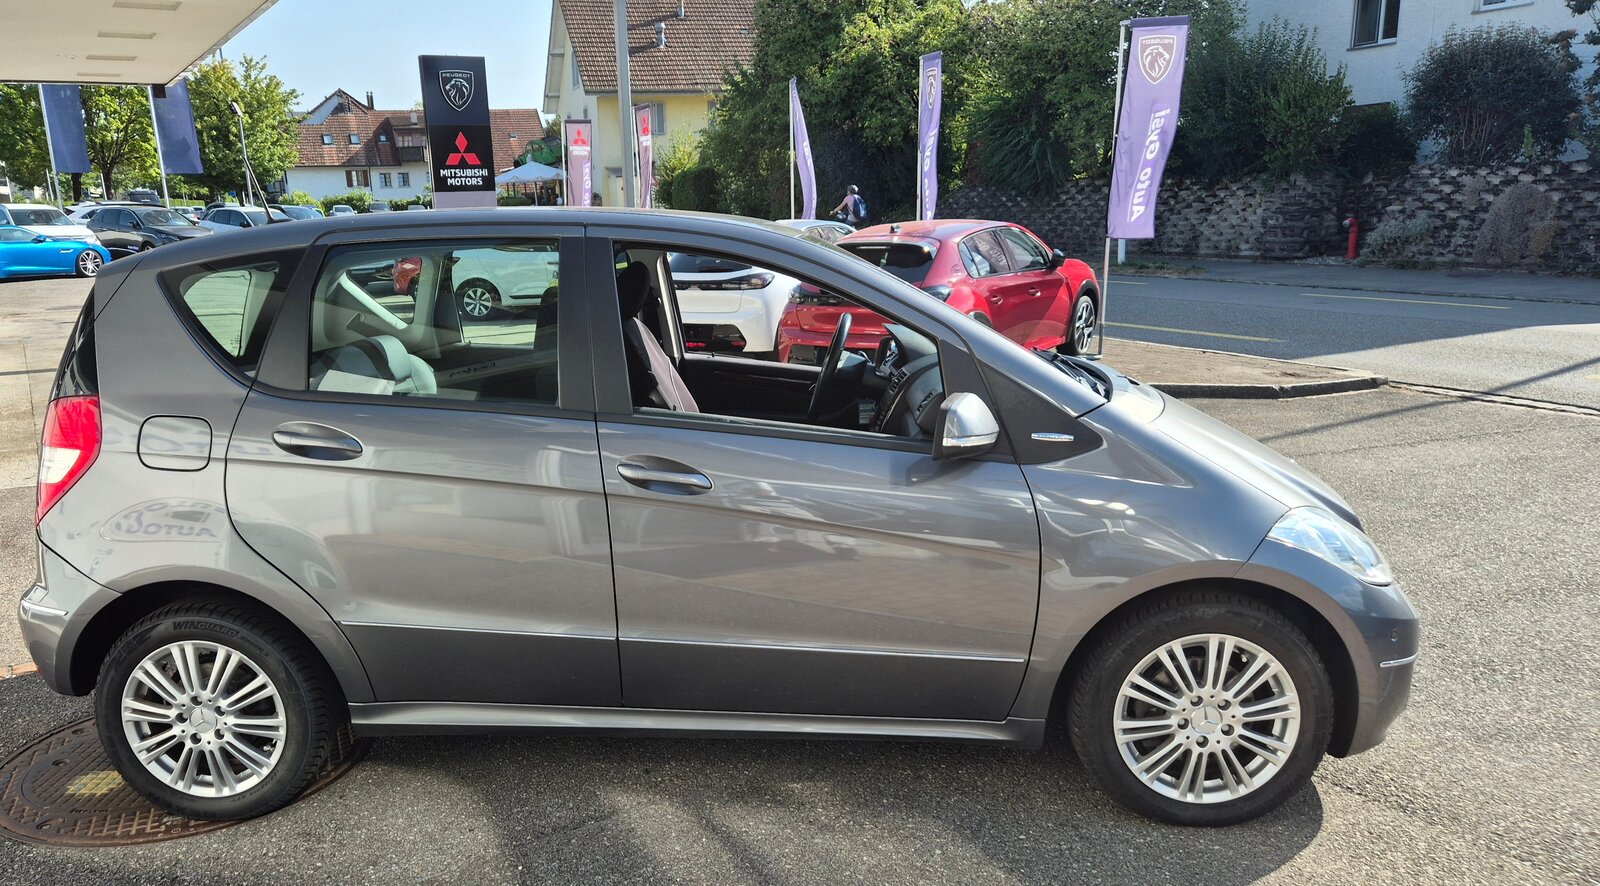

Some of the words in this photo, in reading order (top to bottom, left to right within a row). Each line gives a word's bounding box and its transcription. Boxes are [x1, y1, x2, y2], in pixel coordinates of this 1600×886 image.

[440, 169, 488, 177] MITSUBISHI
[447, 177, 483, 186] MOTORS
[172, 620, 239, 638] WINGUARD
